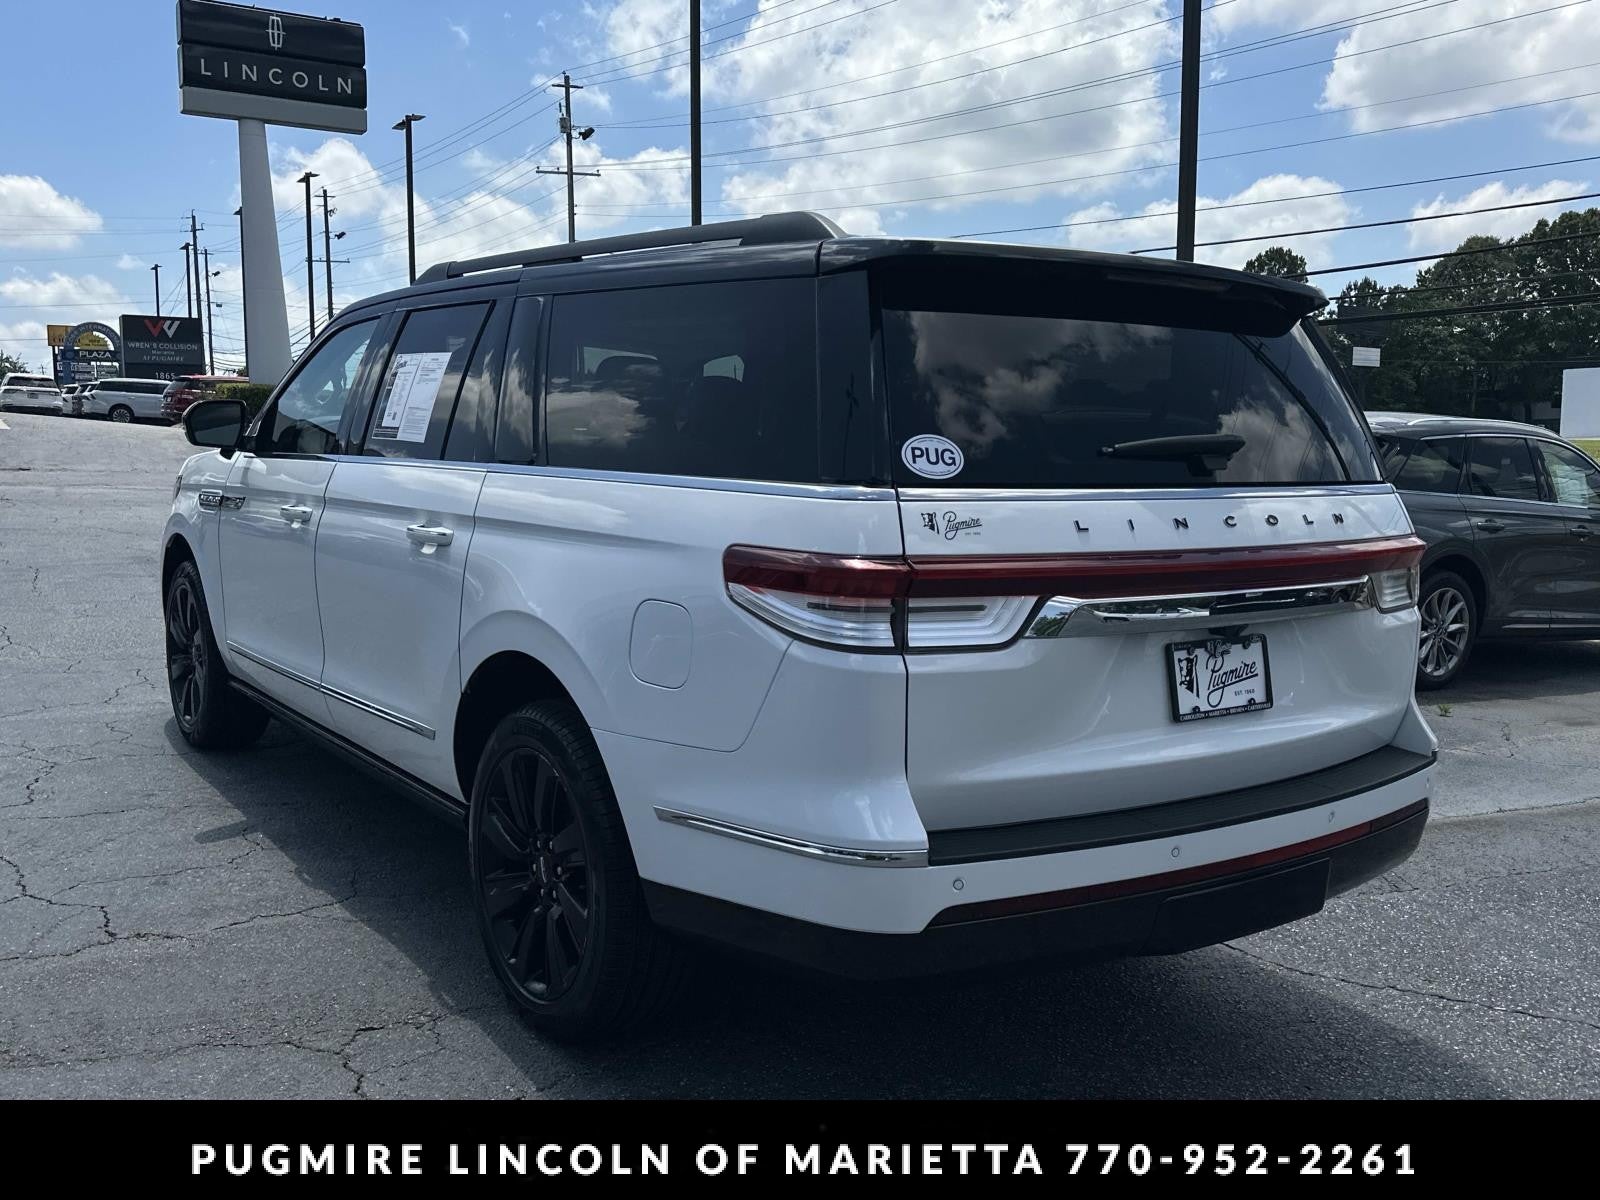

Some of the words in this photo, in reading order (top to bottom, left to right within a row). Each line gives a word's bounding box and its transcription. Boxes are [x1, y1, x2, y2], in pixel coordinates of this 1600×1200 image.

[200, 58, 352, 95] LINCOLN
[79, 350, 112, 359] PLAZA
[158, 342, 199, 351] COLLISION
[155, 371, 176, 380] 1865
[910, 446, 957, 467] PUG
[942, 510, 983, 541] Pugmire
[1073, 512, 1345, 533] LINCOLN
[1205, 653, 1259, 708] Pugmire
